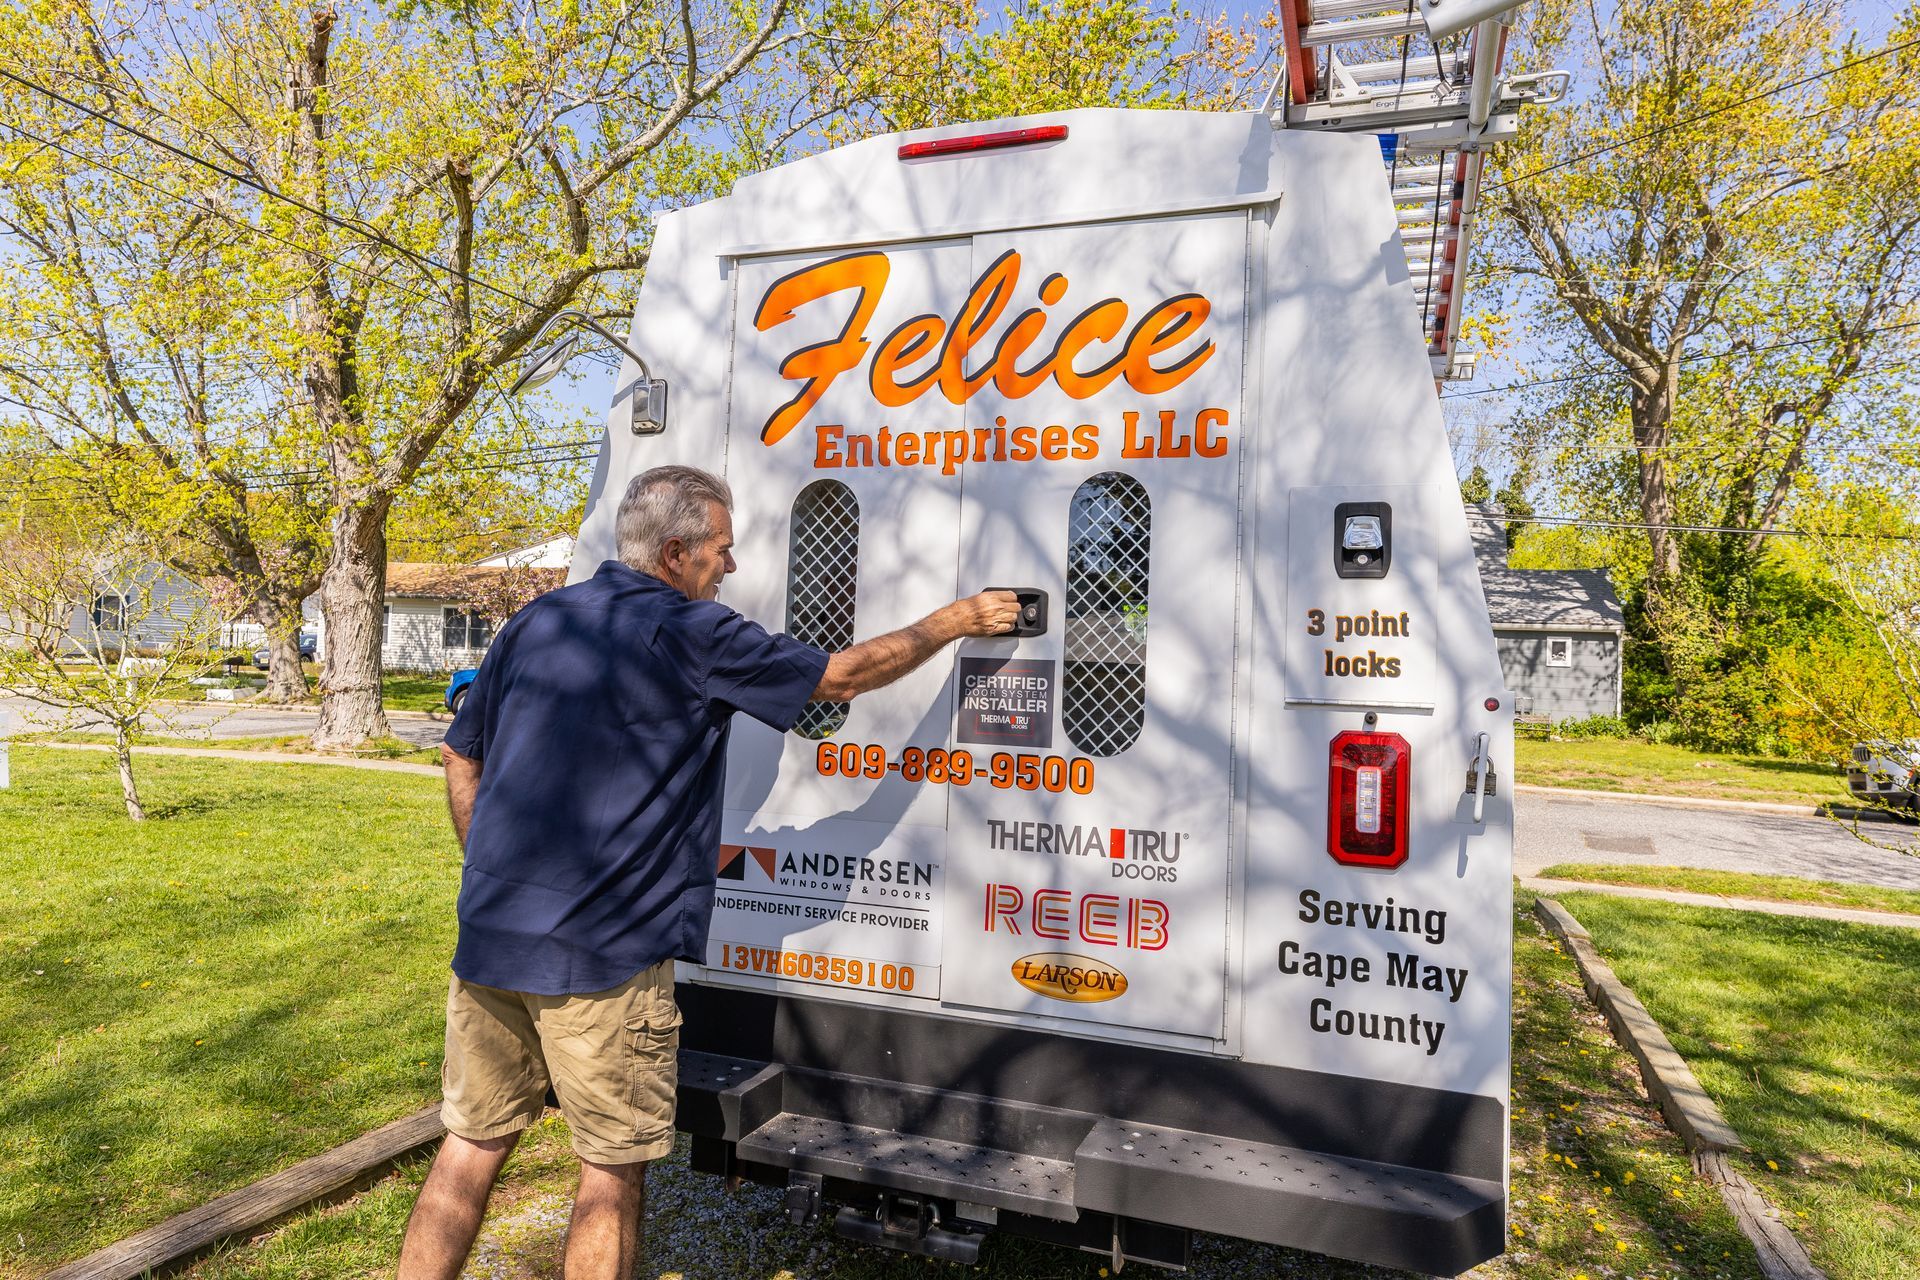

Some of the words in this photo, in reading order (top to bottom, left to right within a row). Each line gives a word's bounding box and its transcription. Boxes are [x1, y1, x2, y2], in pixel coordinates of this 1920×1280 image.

[753, 248, 1216, 447] Felice
[814, 416, 1099, 476] Enterprises
[1121, 408, 1229, 459] LLC
[1306, 607, 1326, 637] 3
[1335, 608, 1410, 643] point
[1324, 649, 1402, 678] locks
[964, 688, 997, 697] DOOR
[1001, 690, 1047, 699] SYSTEM
[965, 674, 1048, 691] CERTIFIED
[964, 696, 1048, 713] INSTALLER
[816, 742, 1095, 795] 609-889-9500
[987, 819, 1106, 858] THERMA
[780, 877, 851, 893] WINDOWS
[861, 885, 869, 895] &
[880, 888, 931, 901] DOORS
[1111, 862, 1178, 883] DOORS
[804, 905, 857, 924] SERVICE
[860, 914, 929, 932] PROVIDER
[984, 883, 1169, 951] REEB
[1298, 889, 1447, 945] Serving
[721, 944, 915, 992] 13VH60359100
[1020, 961, 1120, 995] LARSON
[1278, 940, 1370, 988] Cape
[1386, 952, 1469, 1003] May
[1310, 998, 1446, 1056] County
